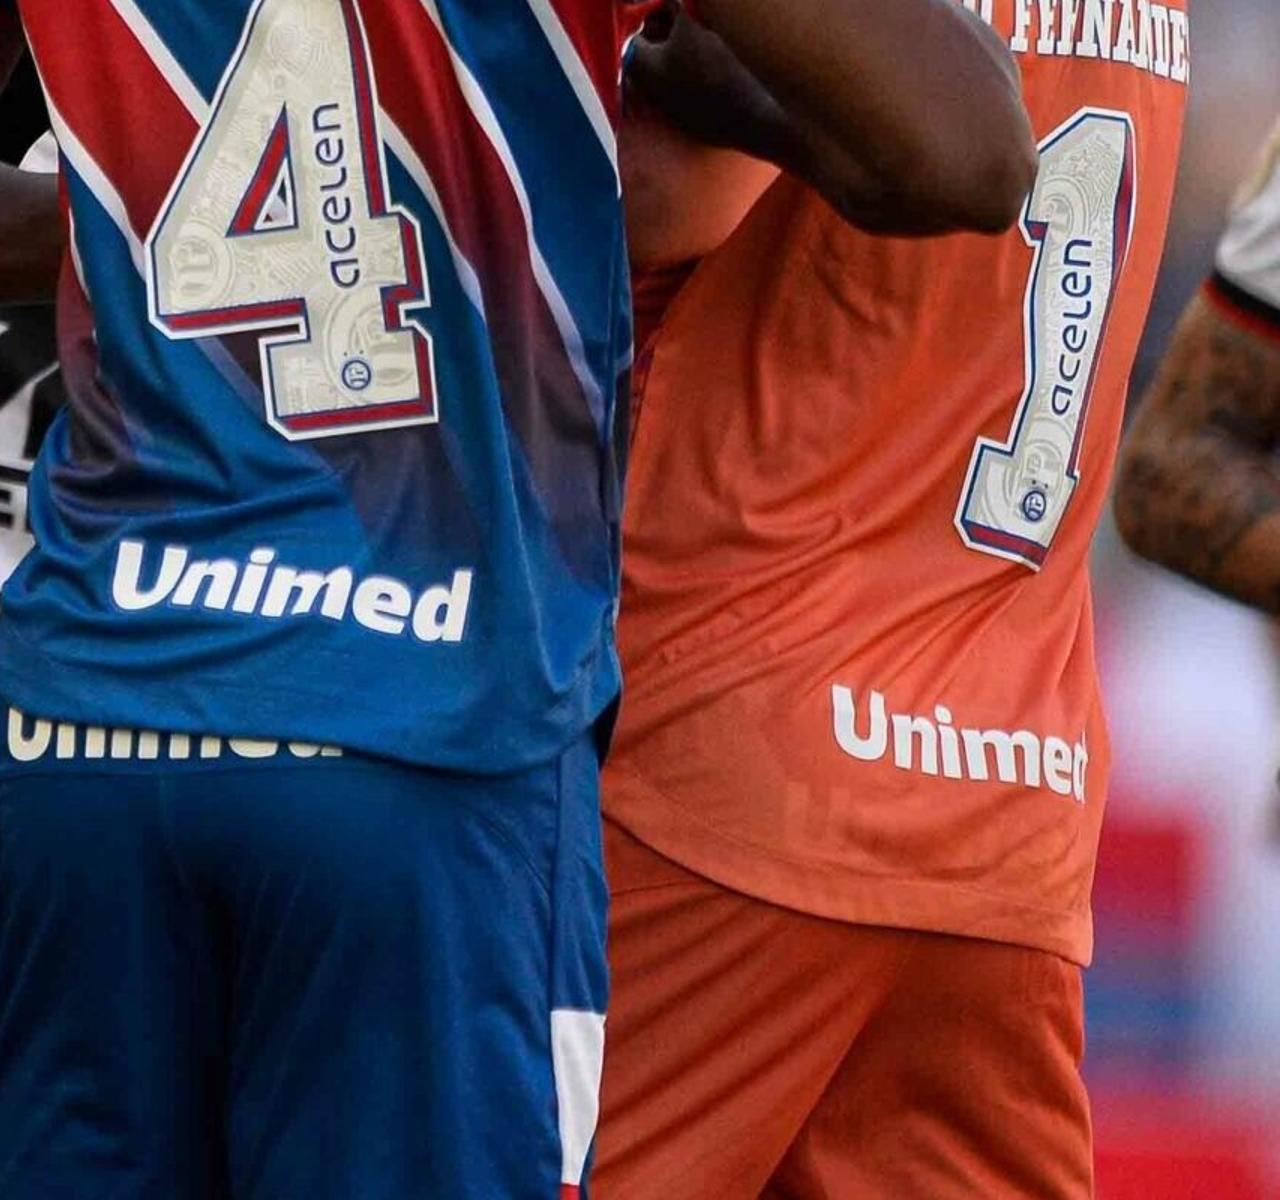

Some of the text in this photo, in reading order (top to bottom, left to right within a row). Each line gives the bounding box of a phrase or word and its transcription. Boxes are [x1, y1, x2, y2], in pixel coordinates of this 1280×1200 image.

[312, 102, 361, 290] acelen
[954, 106, 1137, 572] 1
[1050, 238, 1093, 416] acelen
[112, 540, 473, 643] Unimed
